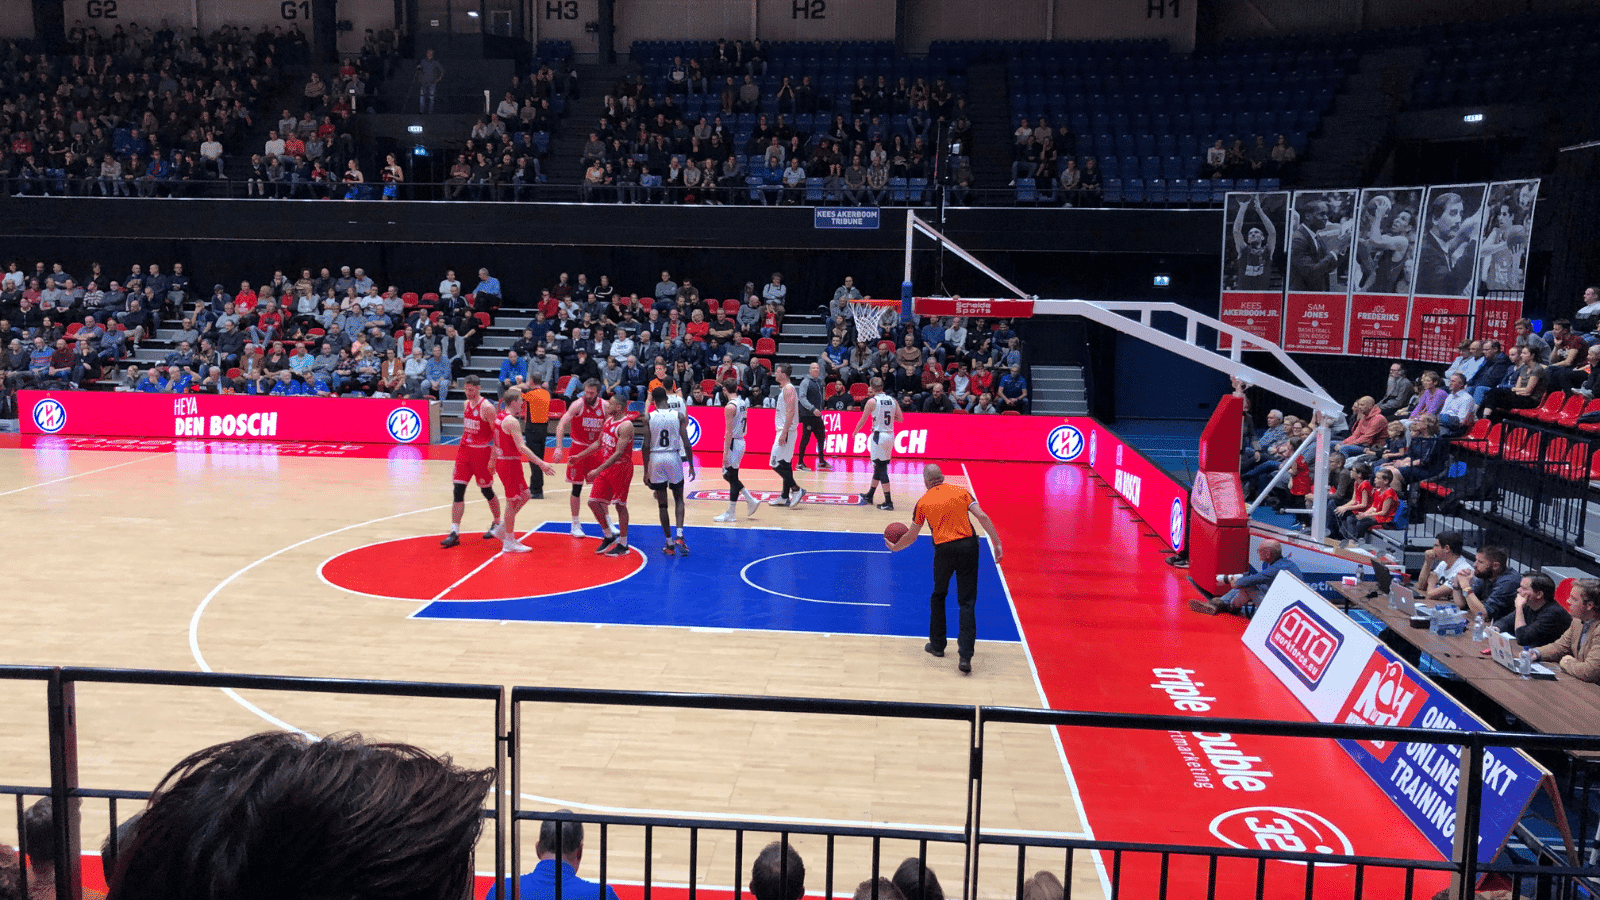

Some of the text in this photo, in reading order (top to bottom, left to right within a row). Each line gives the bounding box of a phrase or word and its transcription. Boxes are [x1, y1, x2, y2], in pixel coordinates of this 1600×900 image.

[87, 0, 118, 19] G2
[281, 0, 310, 20] G1
[545, 0, 579, 20] H3
[792, 0, 826, 20] H2
[1147, 0, 1179, 19] H1
[816, 210, 878, 218] KEES AKERBOOM
[1223, 309, 1266, 317] AKERBOOM
[1240, 301, 1262, 309] KEES
[1307, 303, 1326, 311] SAM
[1371, 303, 1386, 313] JOS
[1302, 311, 1329, 319] JONES
[1356, 311, 1400, 322] FREDERIKS
[173, 397, 199, 416] HEYA
[174, 412, 279, 437] DEN BOSCH
[821, 413, 842, 432] EYA
[883, 410, 892, 426] 5
[659, 429, 670, 448] 8
[852, 429, 928, 454] BCH
[1279, 611, 1332, 665] OTTO
[1273, 631, 1319, 677] workforce.eu
[1150, 667, 1217, 712] triple
[1191, 730, 1274, 791] ouble
[1405, 741, 1461, 796] ONLINE
[1244, 816, 1307, 852] 32
